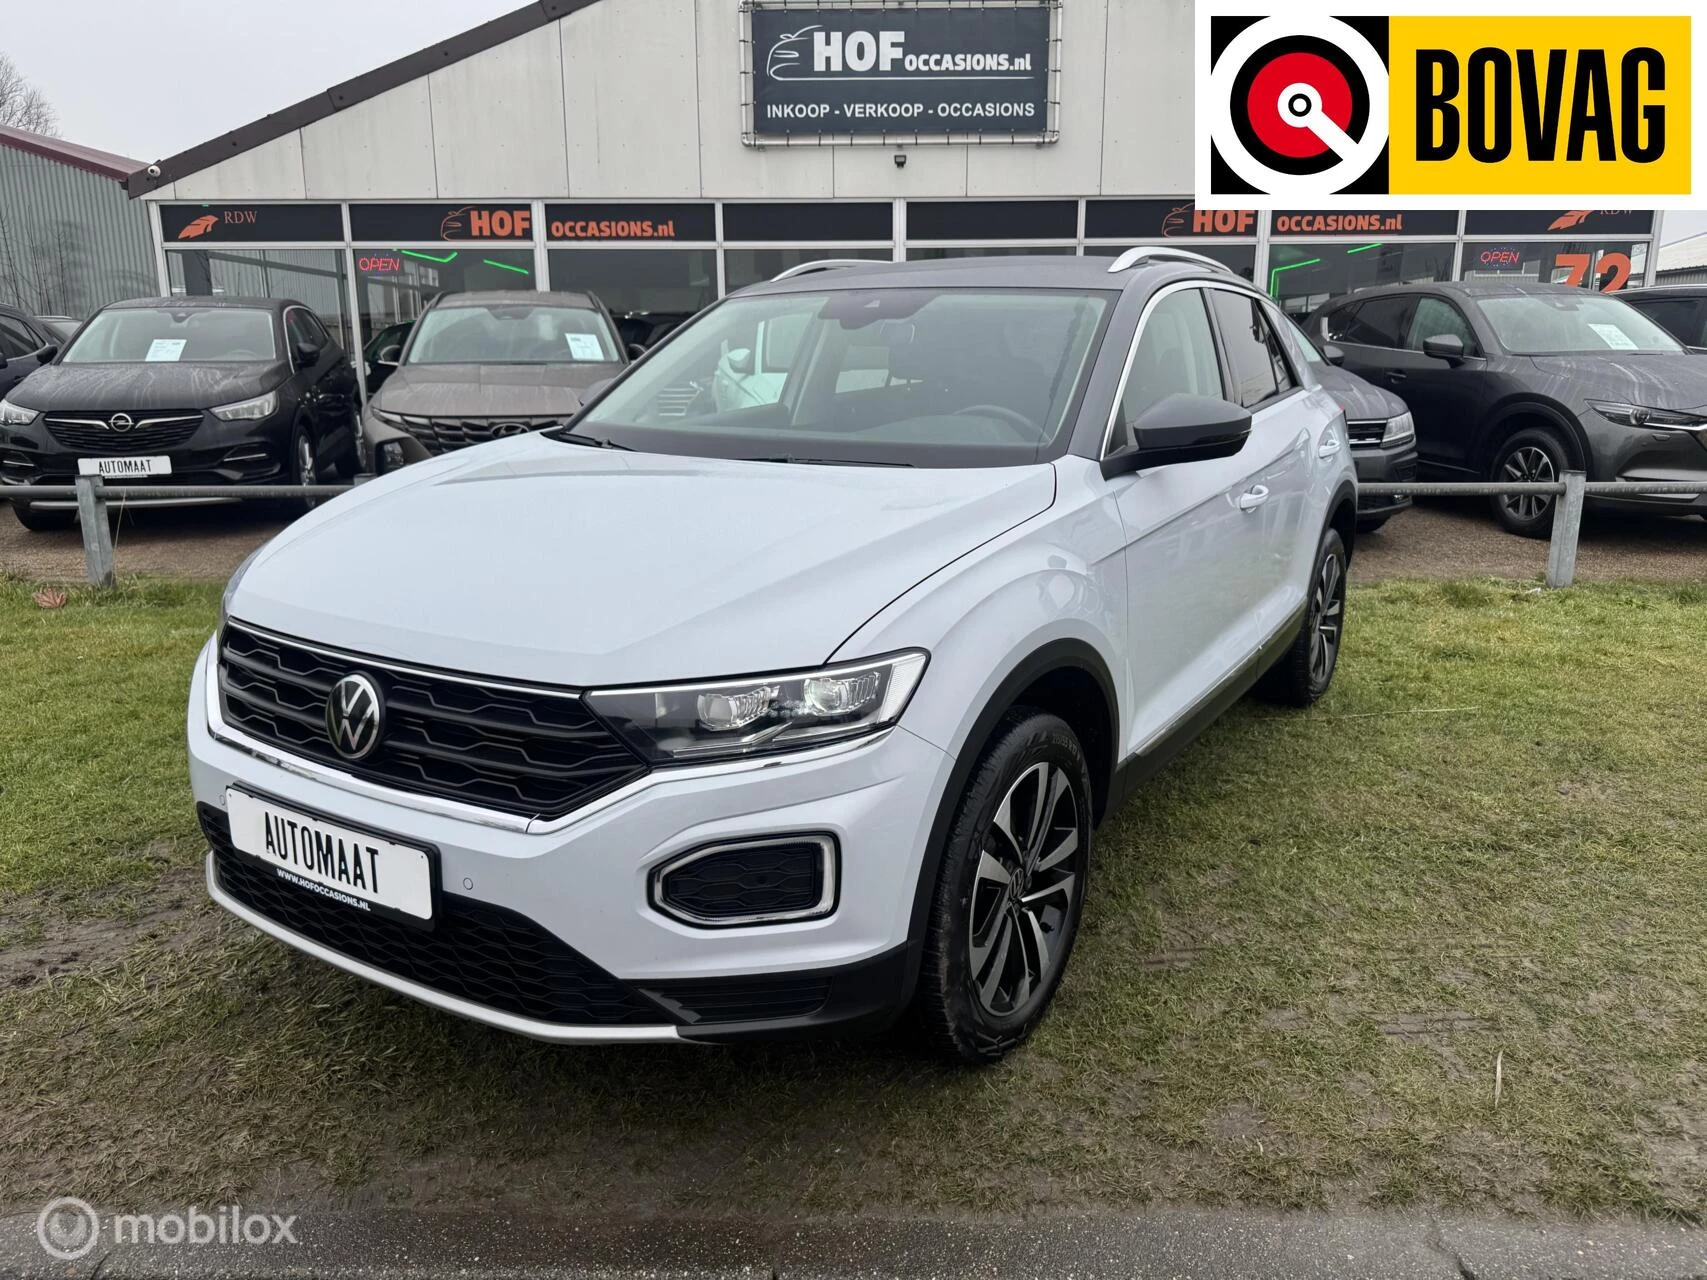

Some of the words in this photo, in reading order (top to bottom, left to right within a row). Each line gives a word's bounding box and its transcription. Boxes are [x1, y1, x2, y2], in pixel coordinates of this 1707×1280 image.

[766, 104, 829, 118] INKOOP
[843, 103, 924, 118] VERKOOP
[937, 102, 1035, 117] OCCASIONS
[223, 211, 258, 224] RDW
[470, 210, 531, 236] HOF
[551, 220, 675, 238] OCCASIONS.nl
[1192, 209, 1255, 233] HOF
[1276, 214, 1402, 232] OCCASIONS.nl
[358, 257, 401, 272] OPEN
[1480, 251, 1520, 265] OPEN
[1555, 252, 1632, 293] 72
[99, 460, 151, 474] AUTOMAAT
[264, 811, 379, 894] AUTOMAAT
[276, 867, 372, 912] WWW.HOFOCCASIONS.NL
